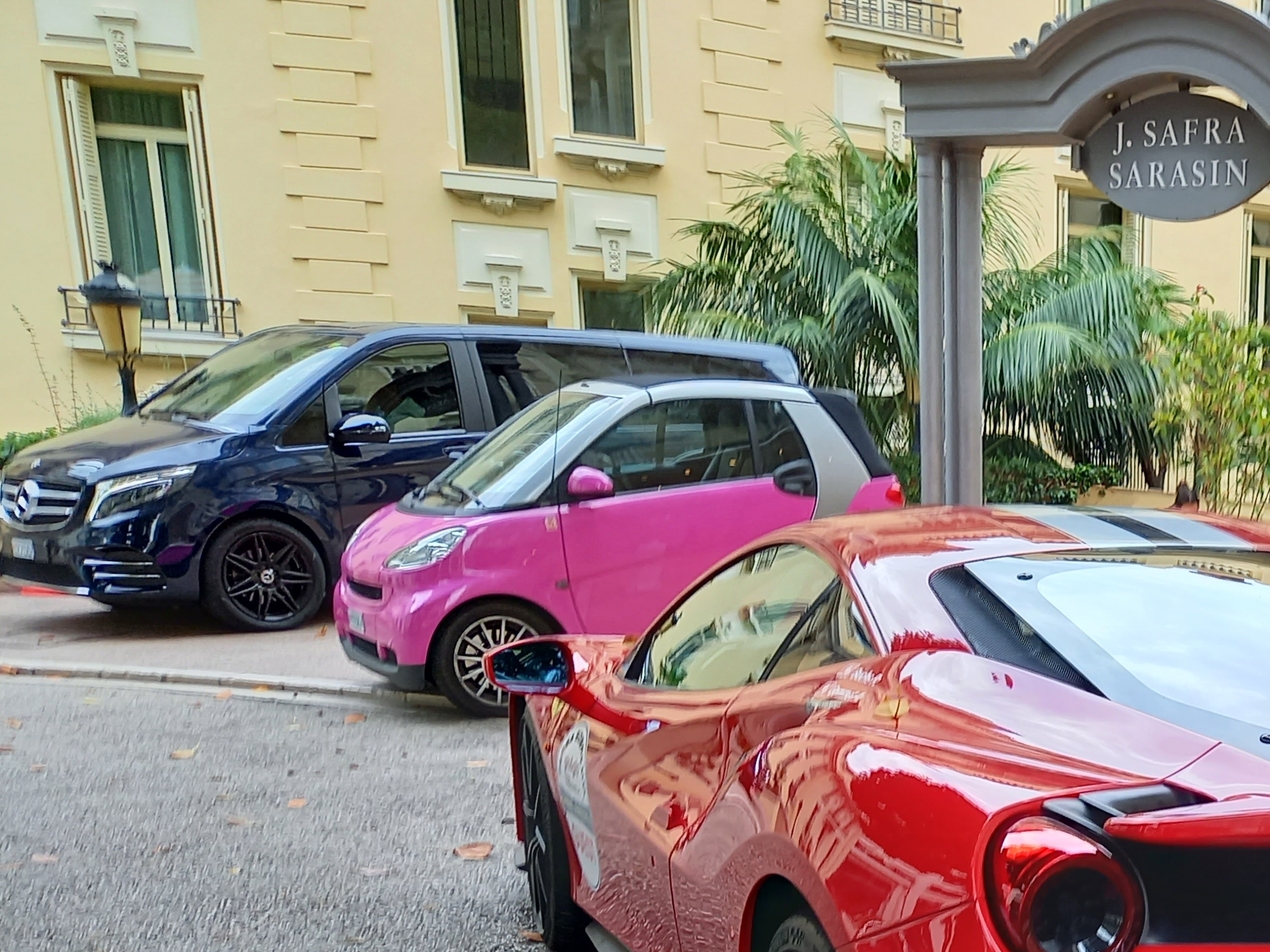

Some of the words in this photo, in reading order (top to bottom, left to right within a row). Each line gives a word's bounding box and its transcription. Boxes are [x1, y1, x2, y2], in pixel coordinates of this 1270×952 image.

[1112, 121, 1132, 156] J.
[1143, 116, 1245, 147] SAFRA
[1109, 158, 1248, 190] SARASIN
